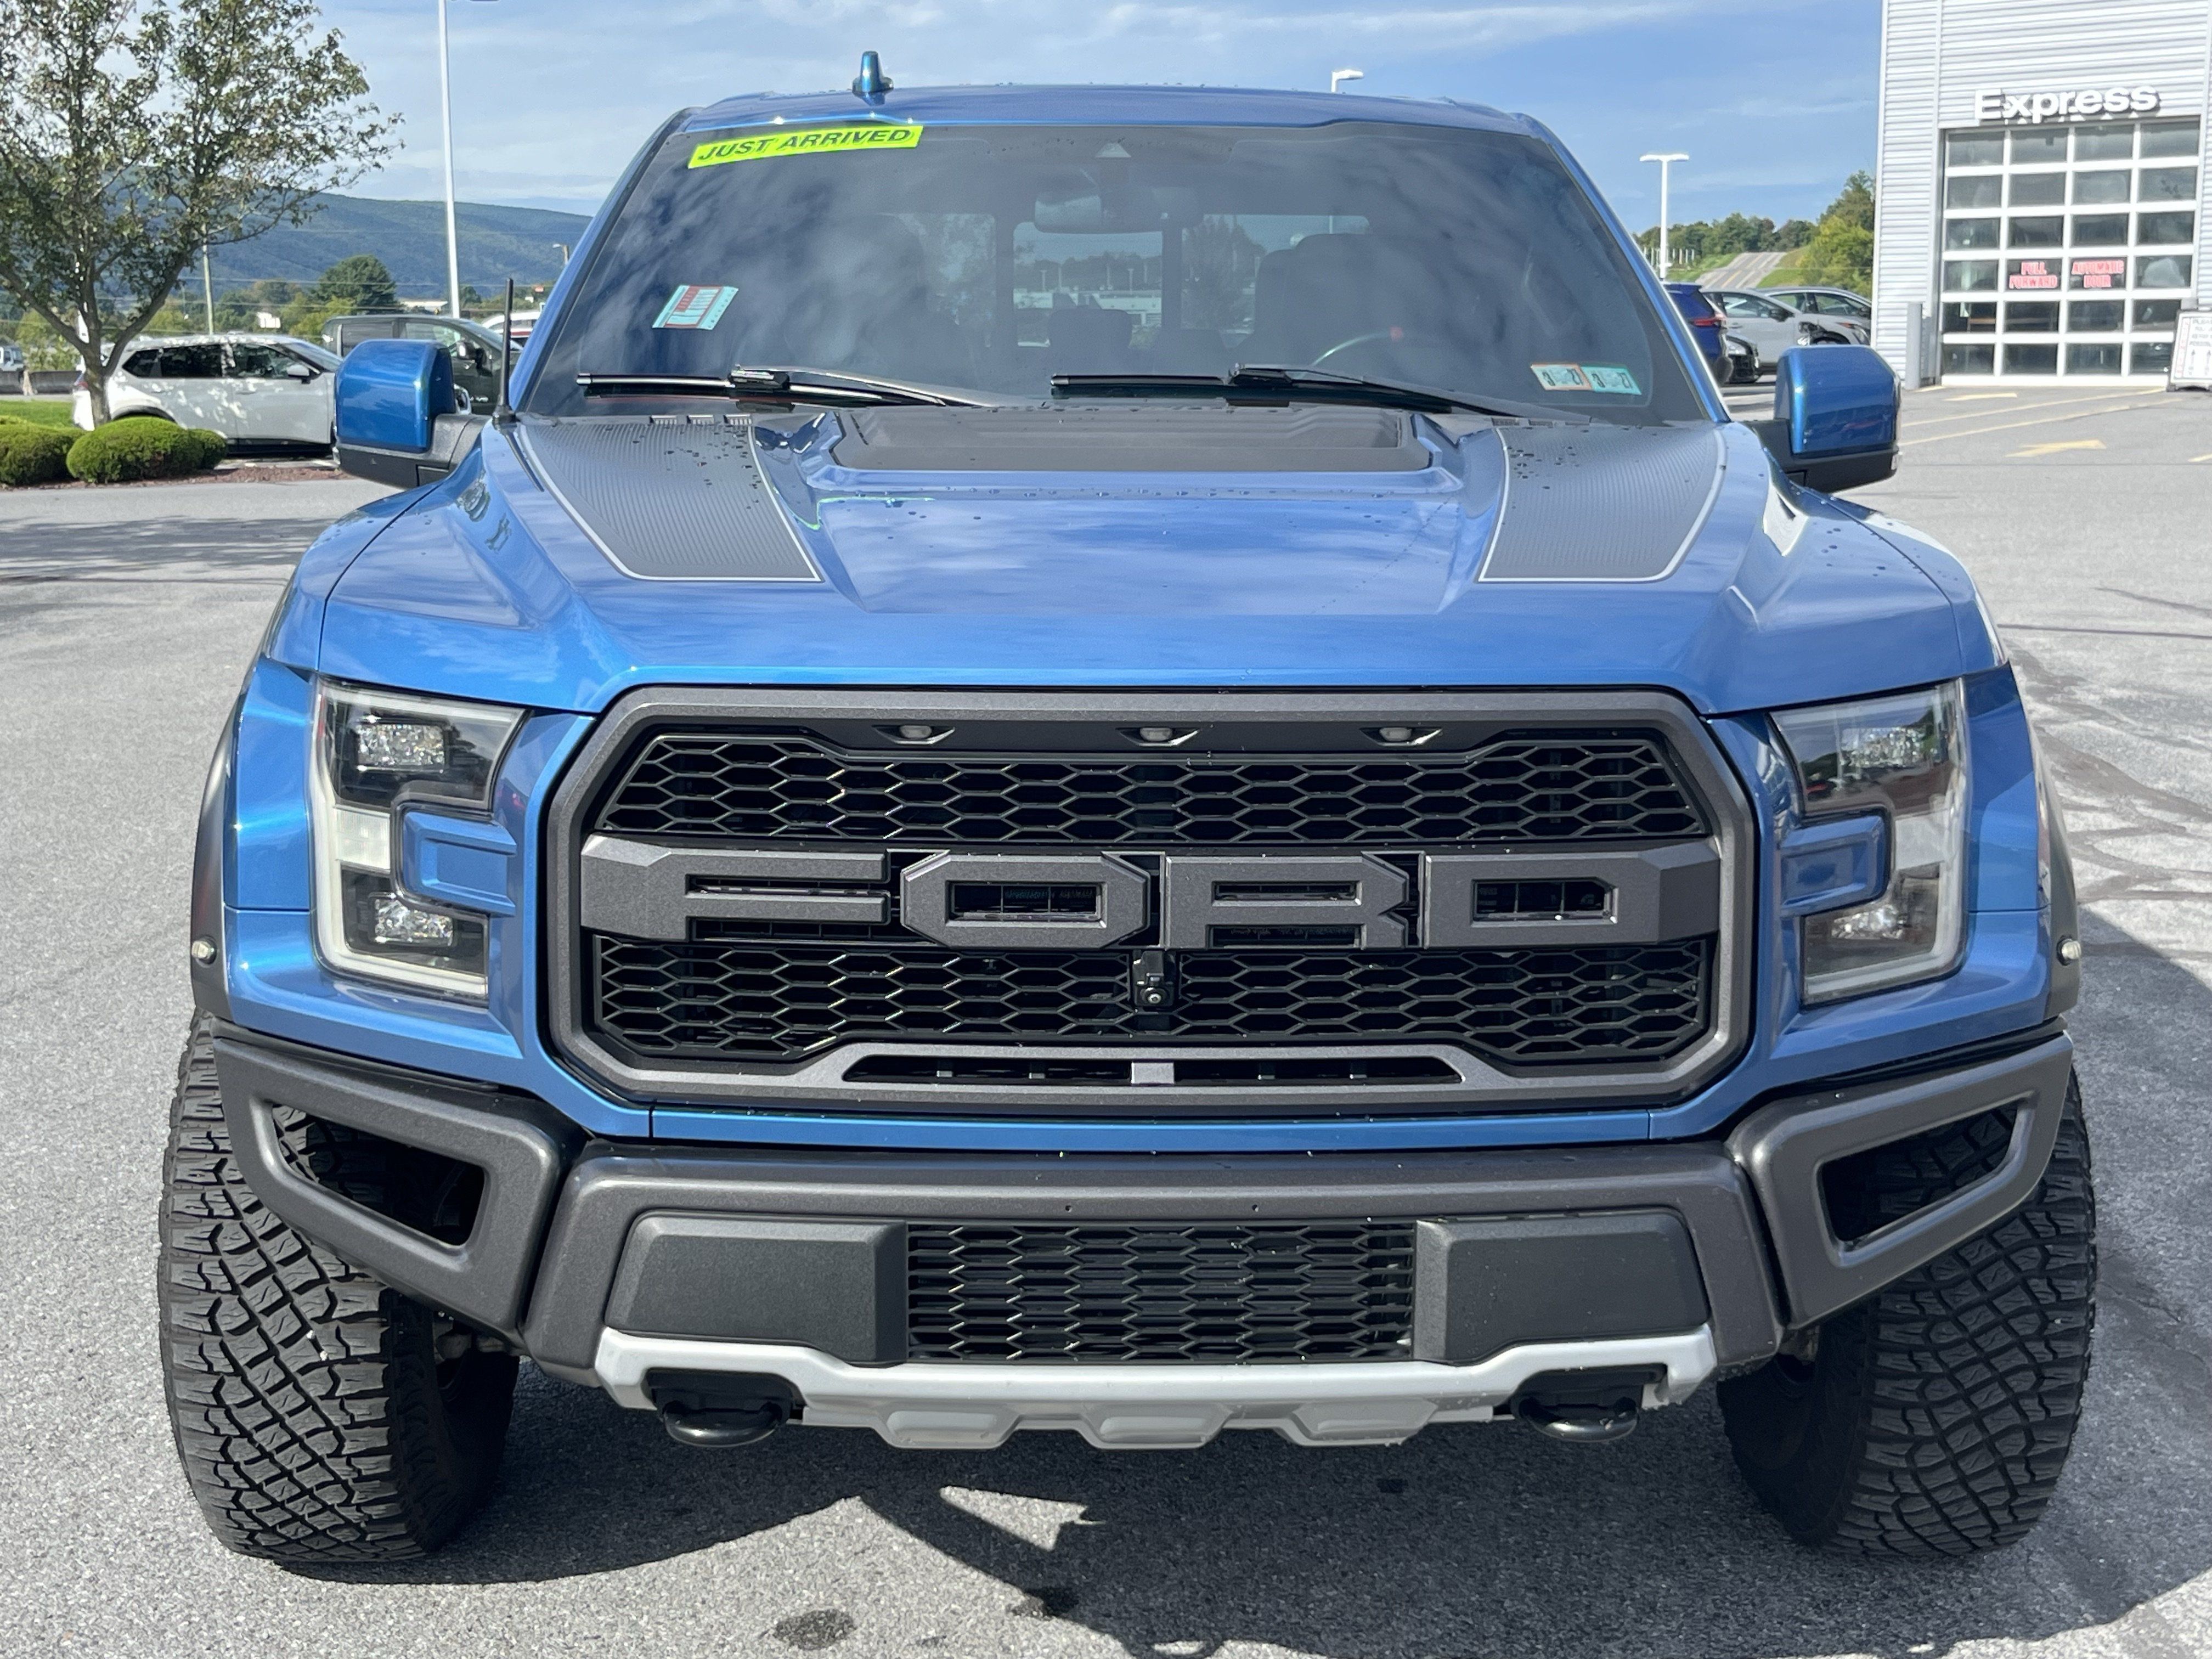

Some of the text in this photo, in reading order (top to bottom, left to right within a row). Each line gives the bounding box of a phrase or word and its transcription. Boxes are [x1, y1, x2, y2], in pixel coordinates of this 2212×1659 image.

[1975, 86, 2160, 124] Express
[697, 129, 911, 161] JUST ARRIVED
[2008, 275, 2058, 289] FORWARD
[580, 834, 1720, 945] FORD
